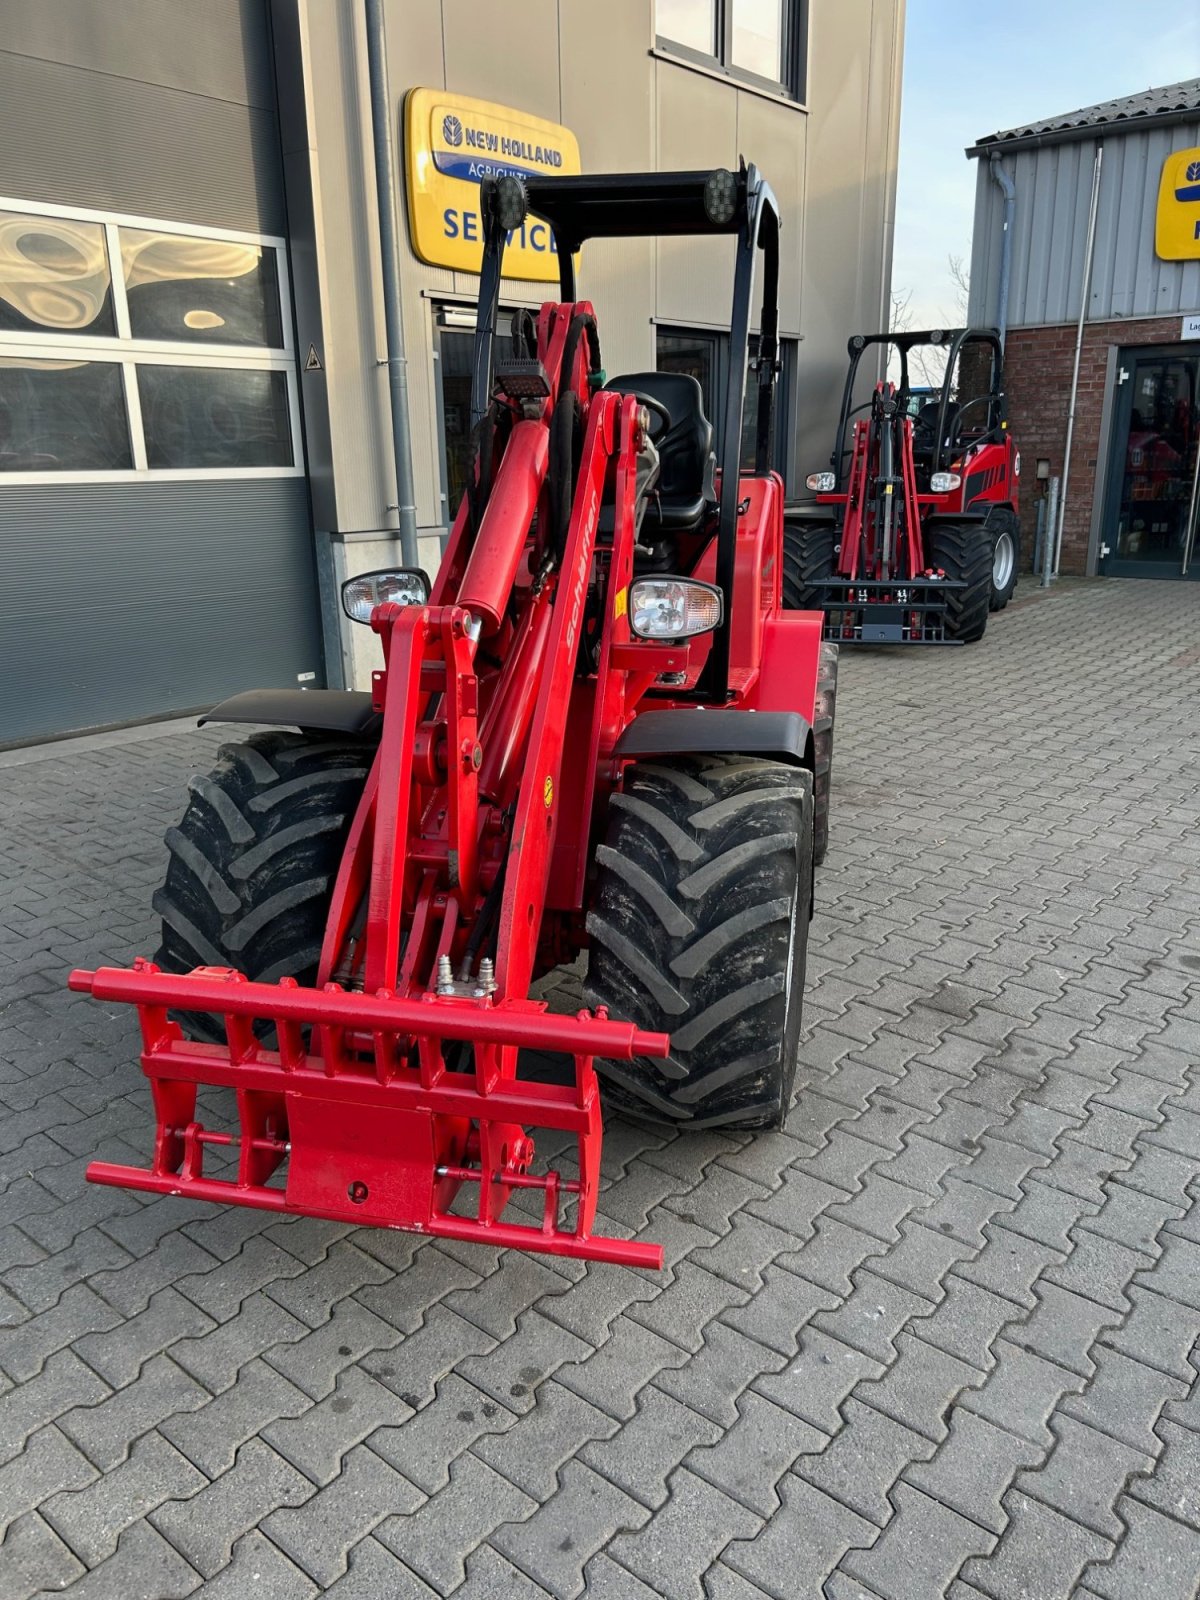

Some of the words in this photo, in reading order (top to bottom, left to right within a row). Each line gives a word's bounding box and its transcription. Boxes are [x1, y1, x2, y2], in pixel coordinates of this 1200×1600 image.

[465, 127, 498, 152] NEW
[501, 137, 562, 168] HOLLAND
[443, 208, 557, 253] SEIC
